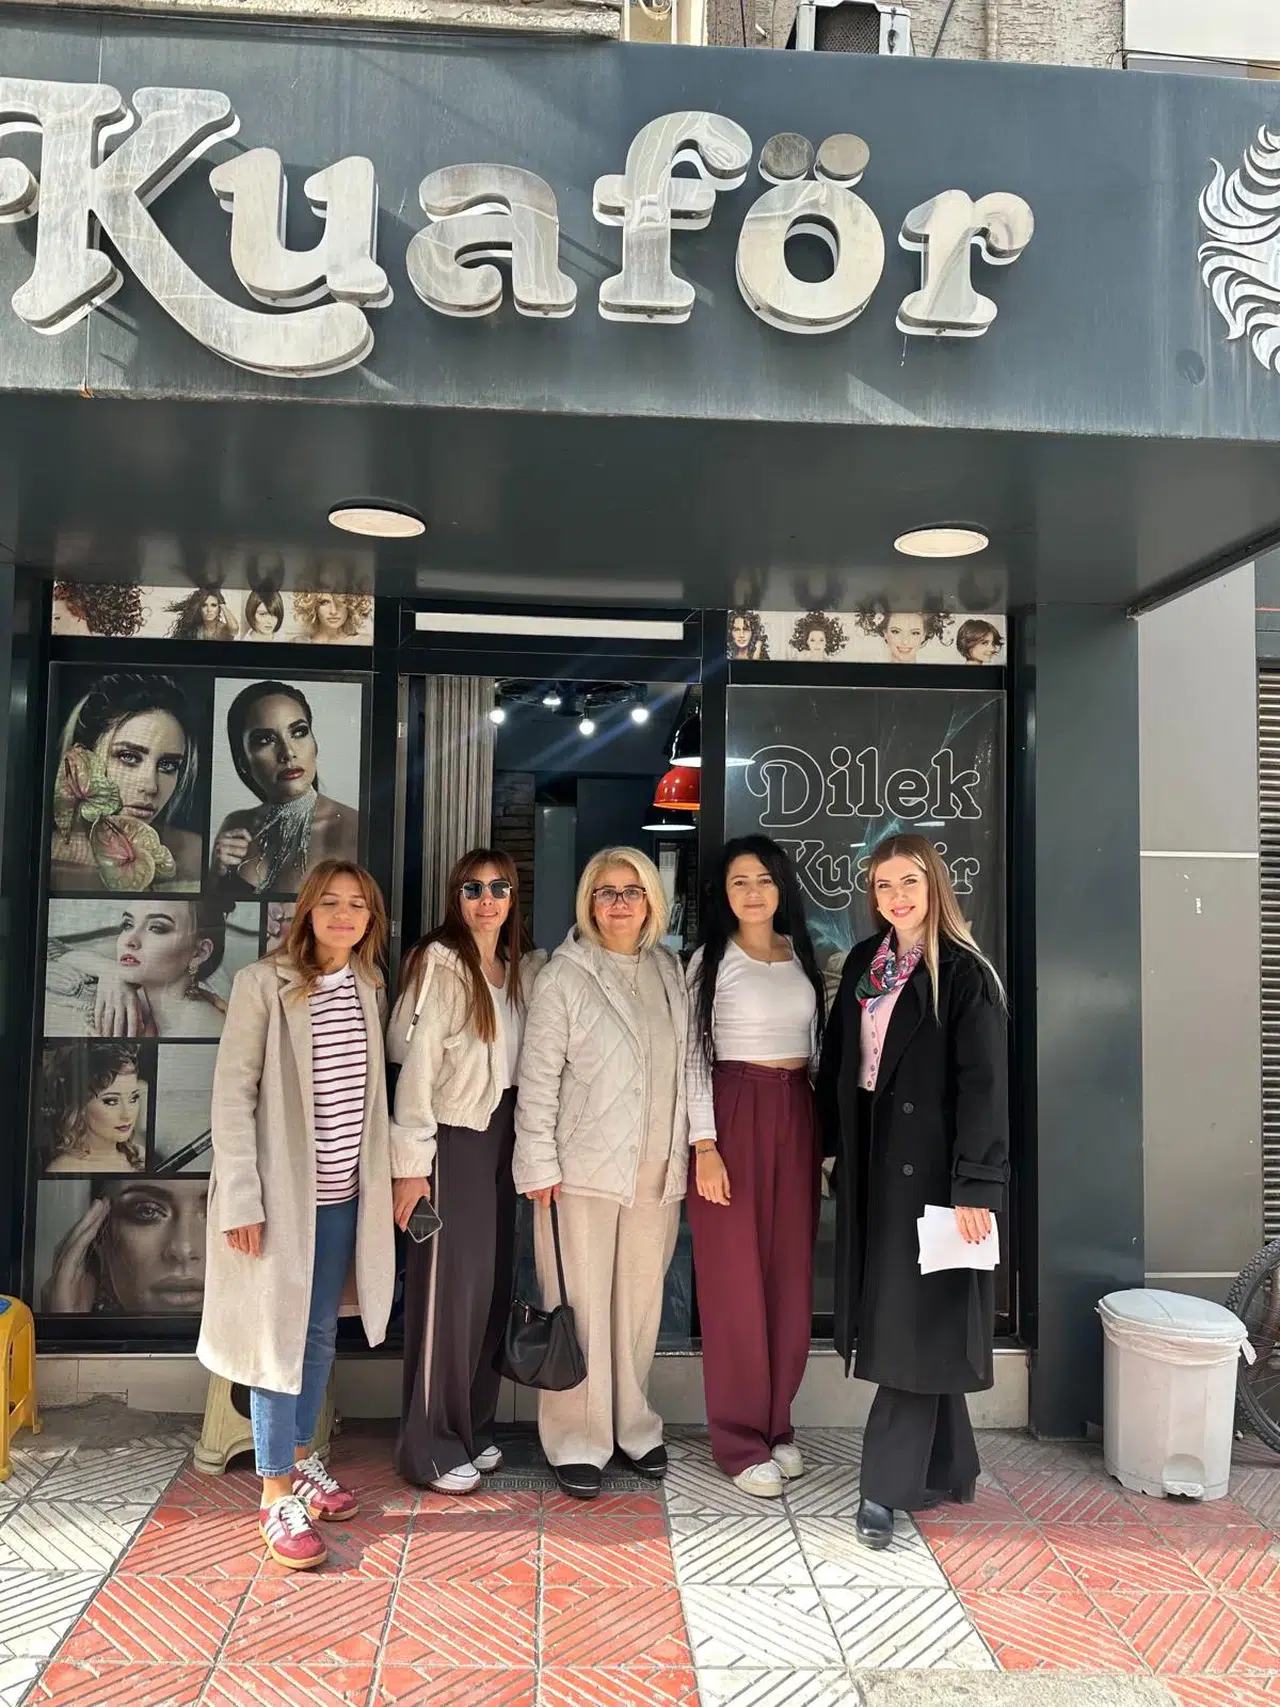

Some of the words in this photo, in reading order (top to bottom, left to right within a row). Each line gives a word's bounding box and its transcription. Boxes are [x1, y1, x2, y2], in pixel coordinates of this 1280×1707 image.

[0, 77, 1034, 378] Kuaför
[745, 745, 982, 827] Dilek
[773, 839, 981, 911] Kur
